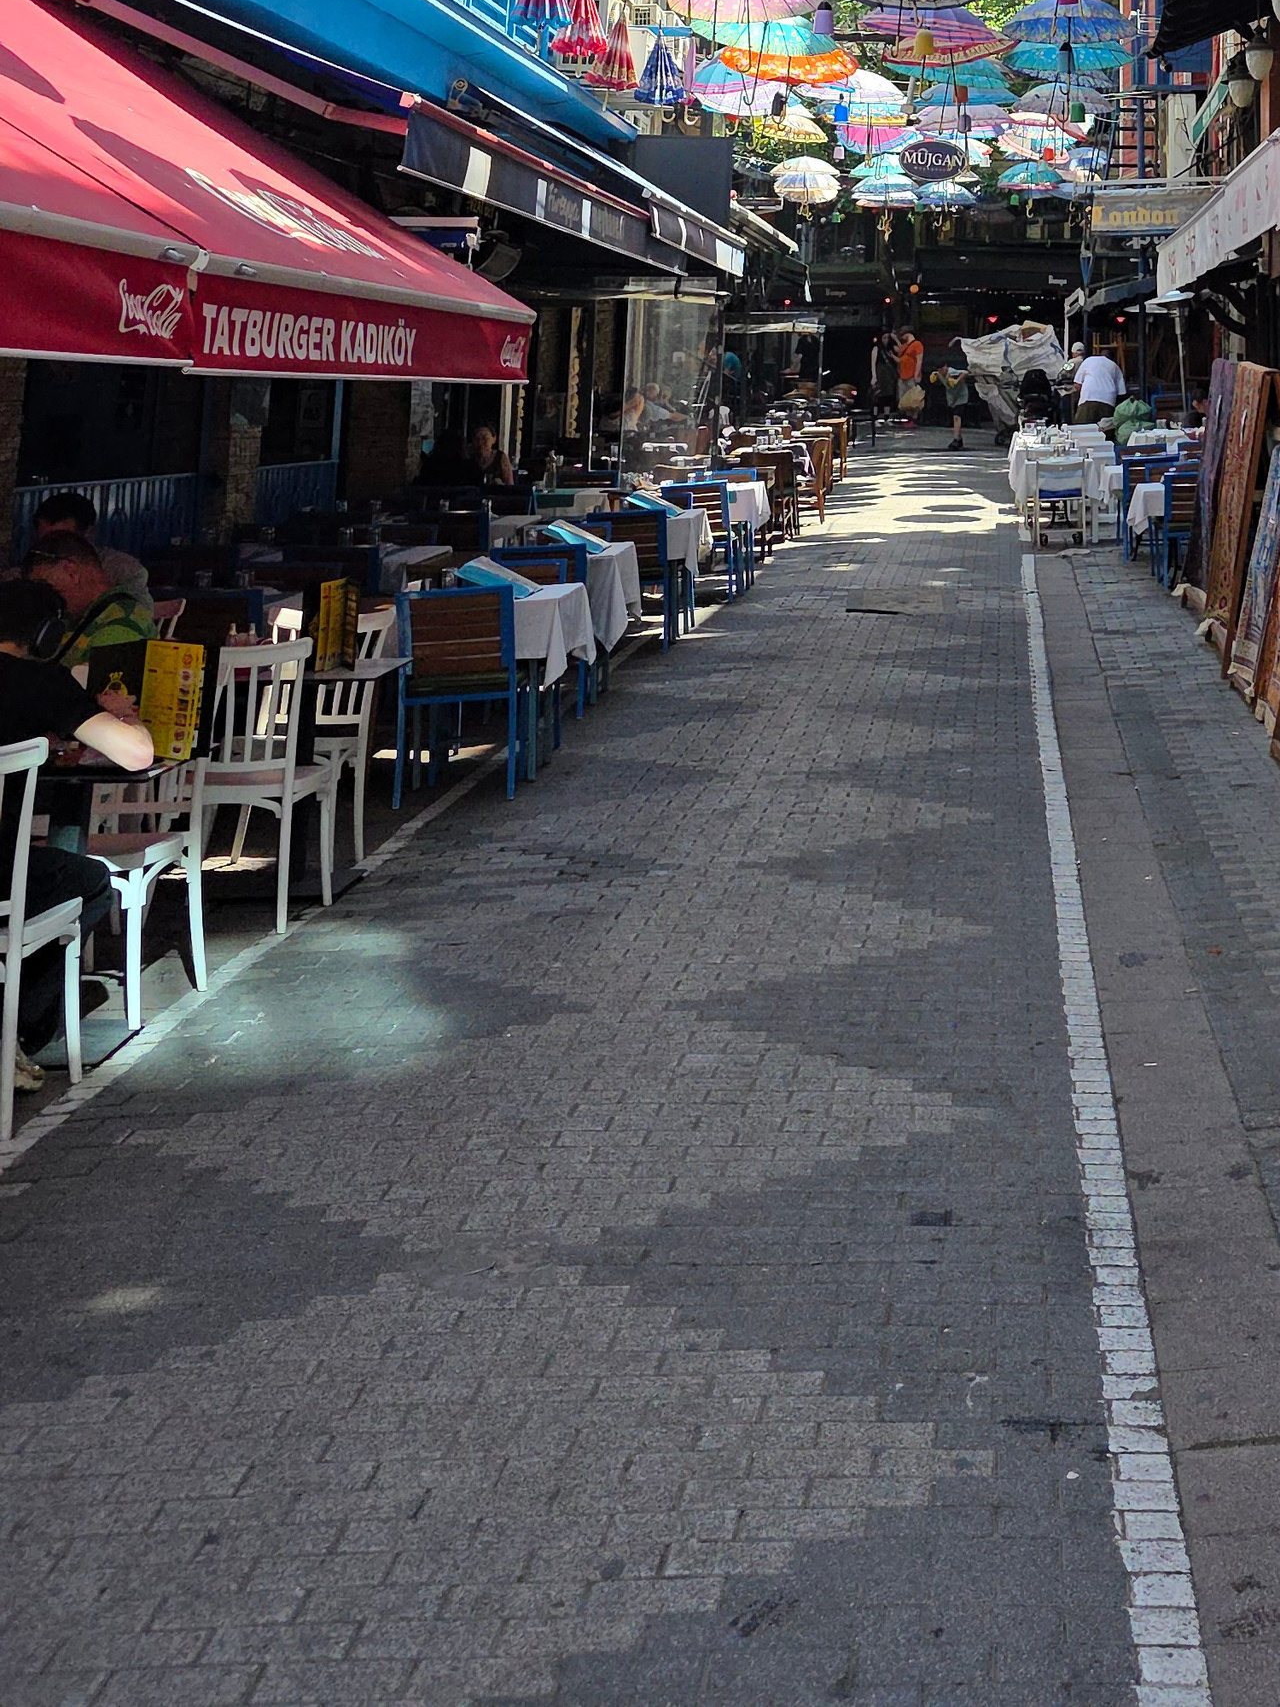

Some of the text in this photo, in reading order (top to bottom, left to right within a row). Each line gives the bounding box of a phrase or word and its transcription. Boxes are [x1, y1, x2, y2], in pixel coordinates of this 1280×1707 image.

[1092, 205, 1181, 226] London
[202, 302, 417, 367] TATBURGER KADIKÖY
